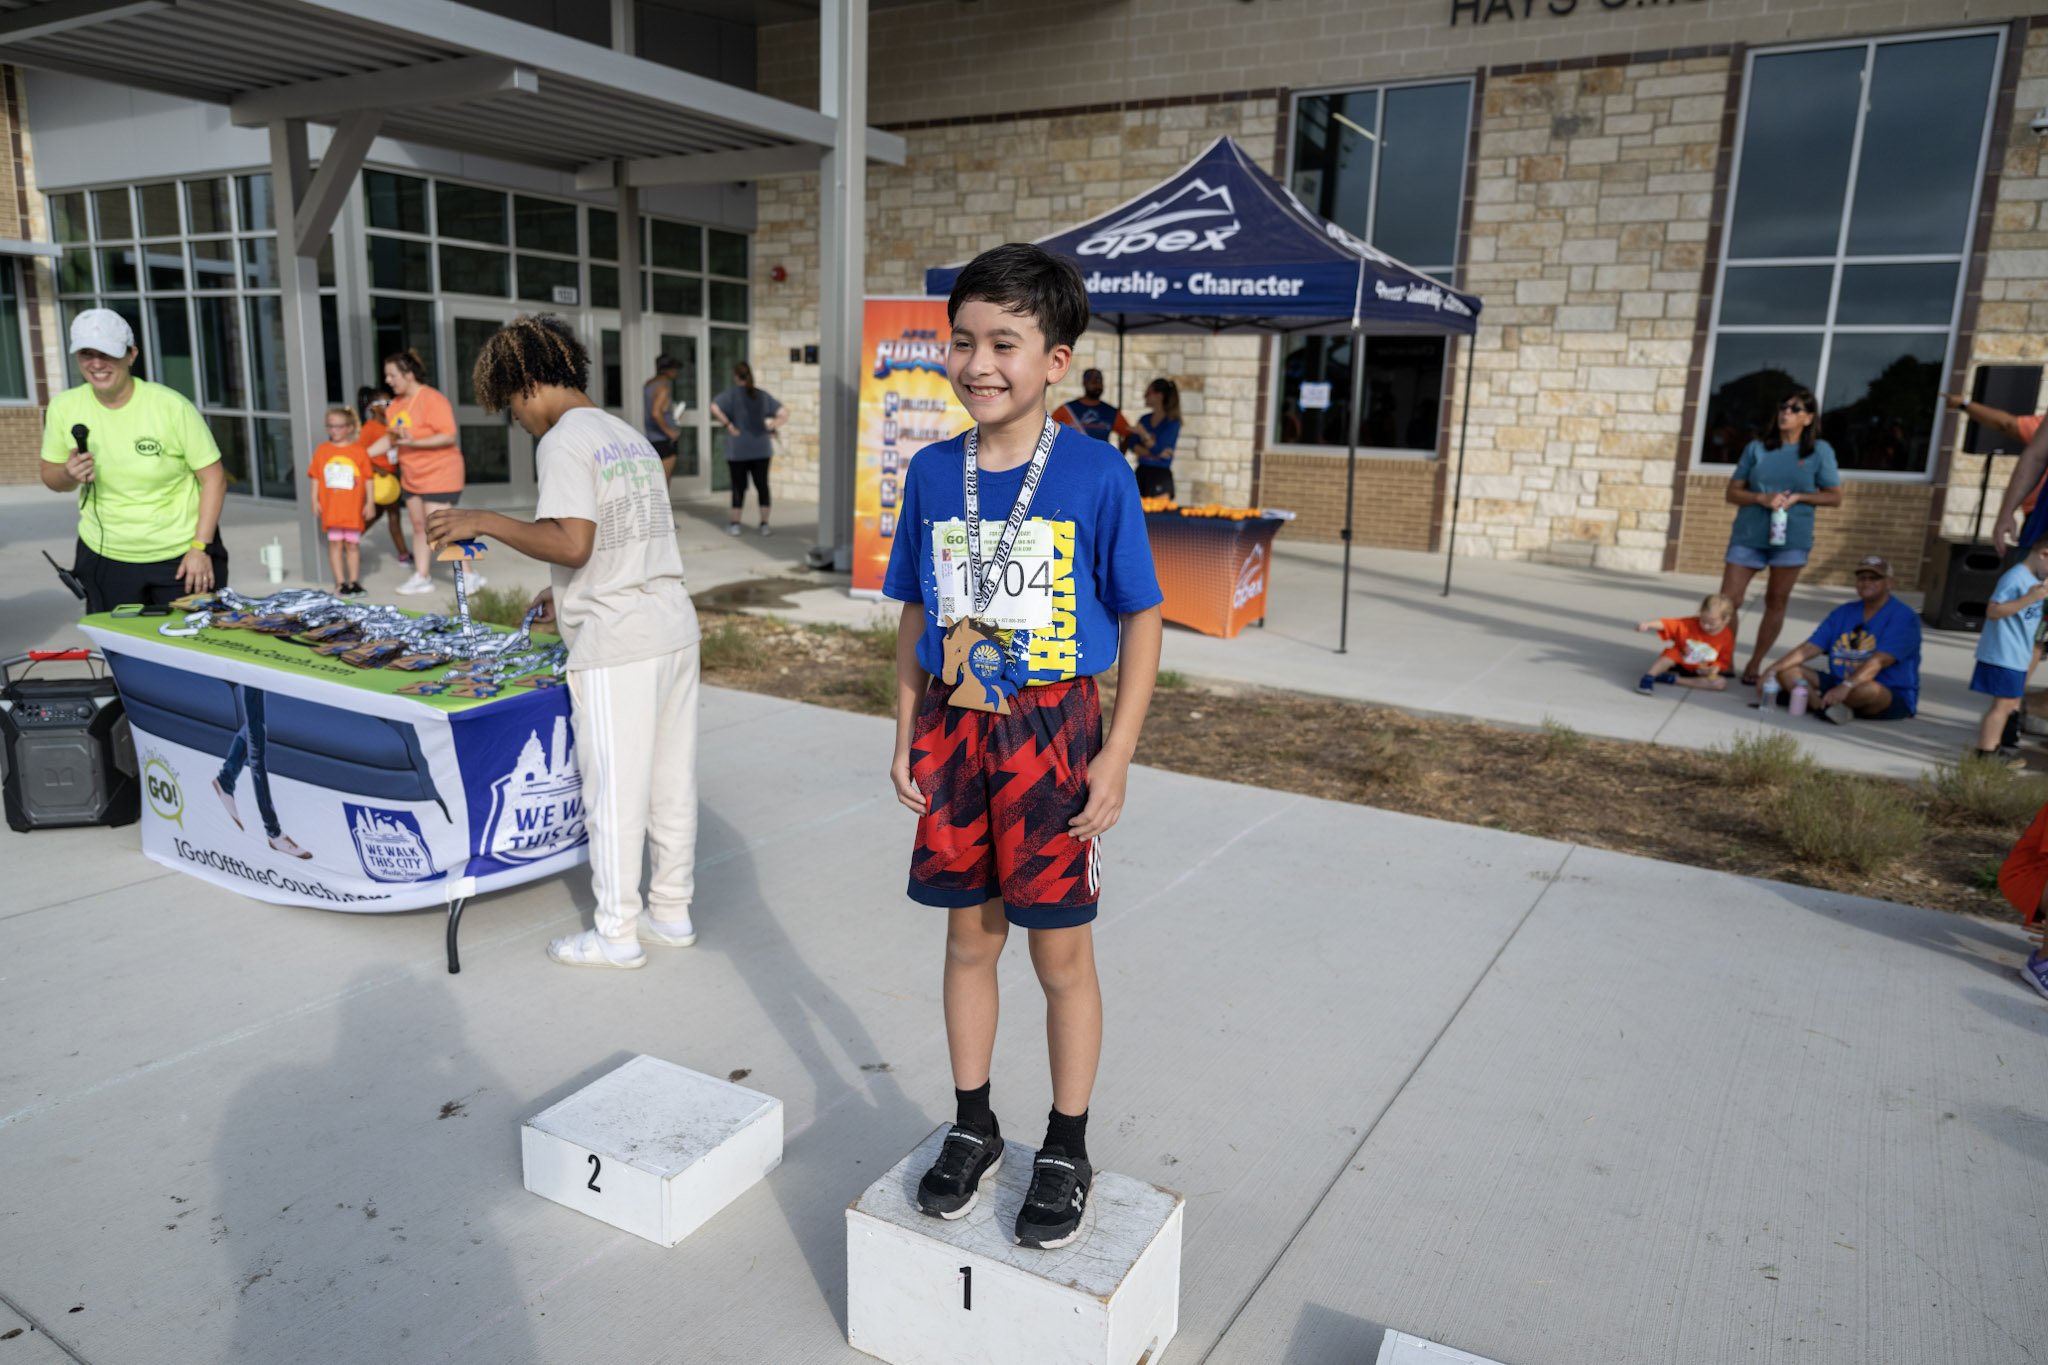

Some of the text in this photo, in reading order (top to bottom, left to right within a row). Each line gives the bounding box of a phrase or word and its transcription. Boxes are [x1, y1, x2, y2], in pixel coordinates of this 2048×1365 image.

[1076, 219, 1241, 260] apex
[1083, 270, 1168, 299] dership
[1187, 272, 1304, 297] Character
[594, 442, 661, 465] VAN HALE
[1038, 428, 1053, 455] 2023
[602, 461, 638, 483] WOD
[639, 459, 664, 473] TOU
[967, 470, 978, 496] 2023
[1024, 462, 1041, 491] 2023
[968, 510, 980, 537] 2023
[1009, 501, 1026, 530] 2023
[970, 551, 981, 578] 2023
[994, 540, 1010, 569] 2023
[1232, 573, 1264, 609] apex
[148, 775, 178, 807] GO!
[515, 805, 556, 831] WE
[365, 843, 419, 857] WE WALK
[509, 826, 563, 849] THIS
[369, 856, 421, 869] THIS CITY
[588, 1154, 601, 1193] 2
[959, 1266, 971, 1311] 1
